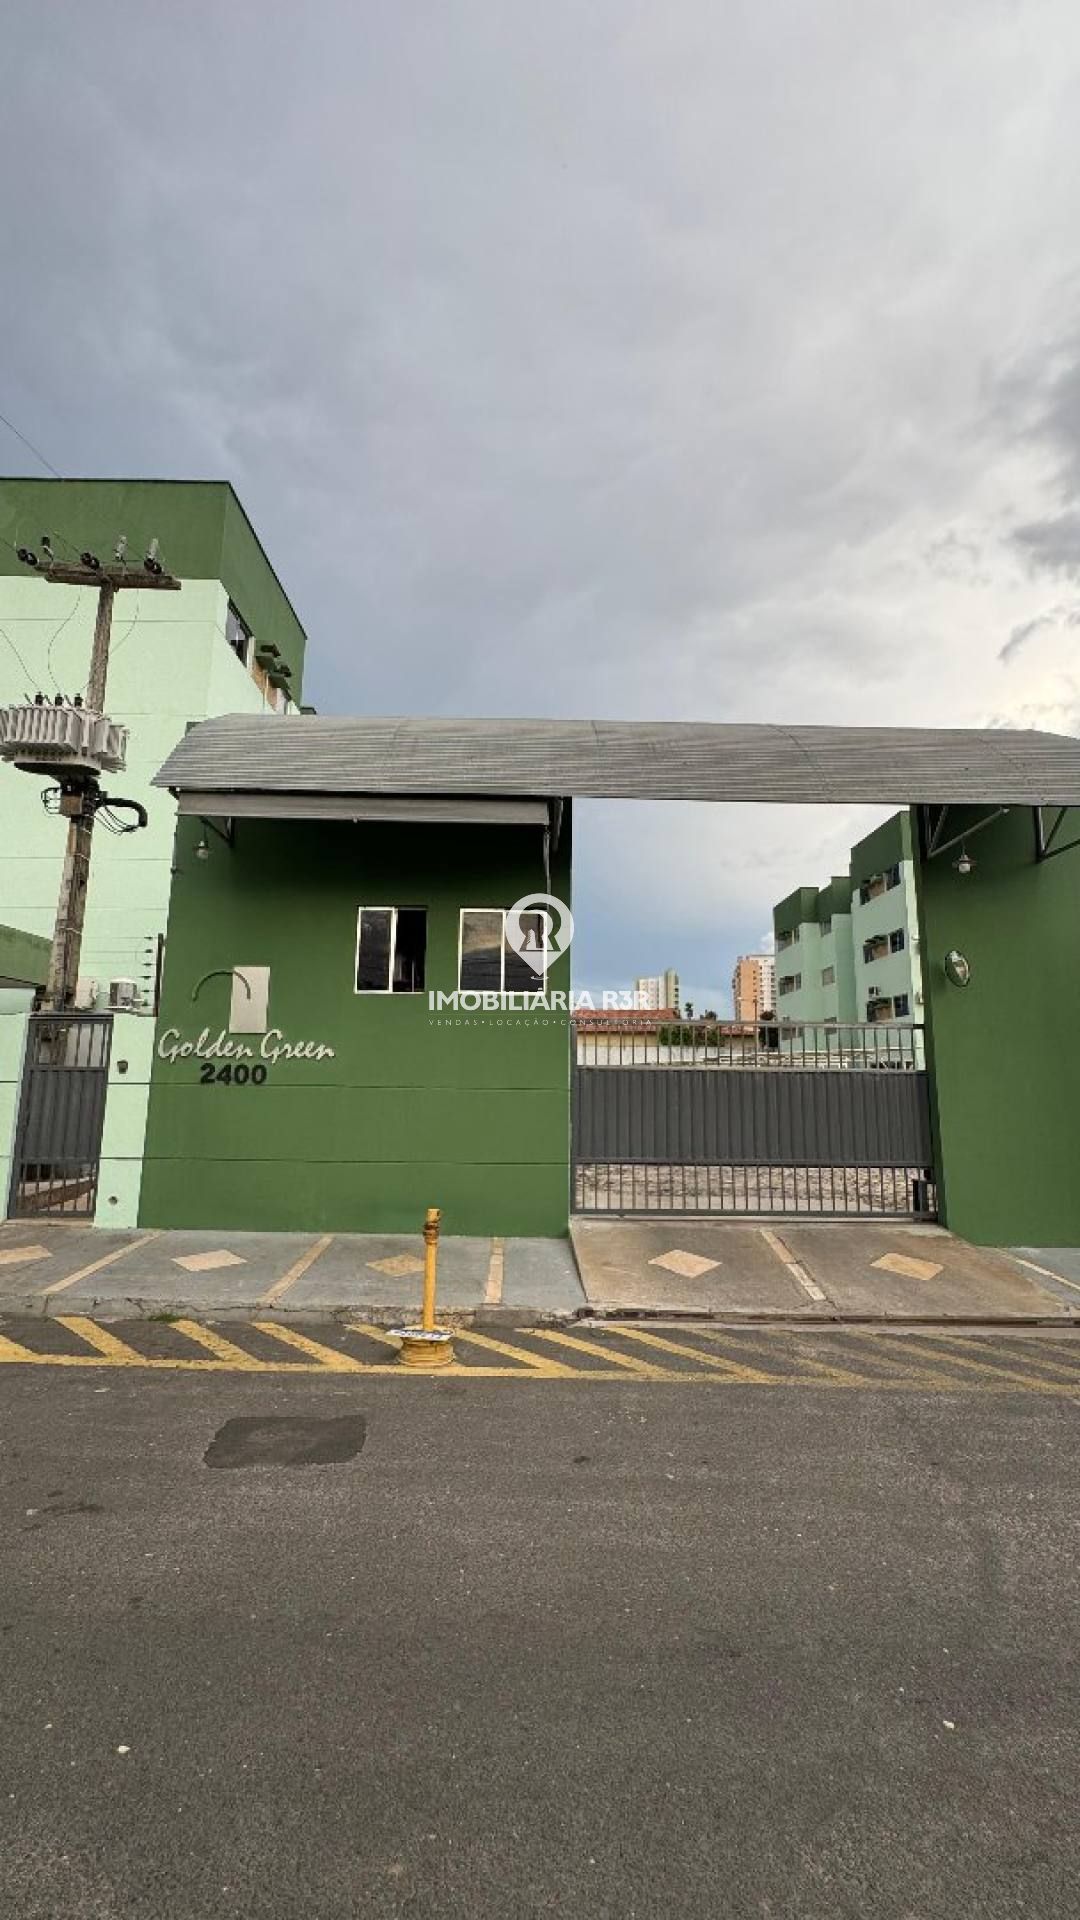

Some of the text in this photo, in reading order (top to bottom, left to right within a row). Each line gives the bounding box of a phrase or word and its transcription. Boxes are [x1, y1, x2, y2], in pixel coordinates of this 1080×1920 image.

[158, 1028, 335, 1064] Golden Green
[200, 1063, 268, 1085] 2400
